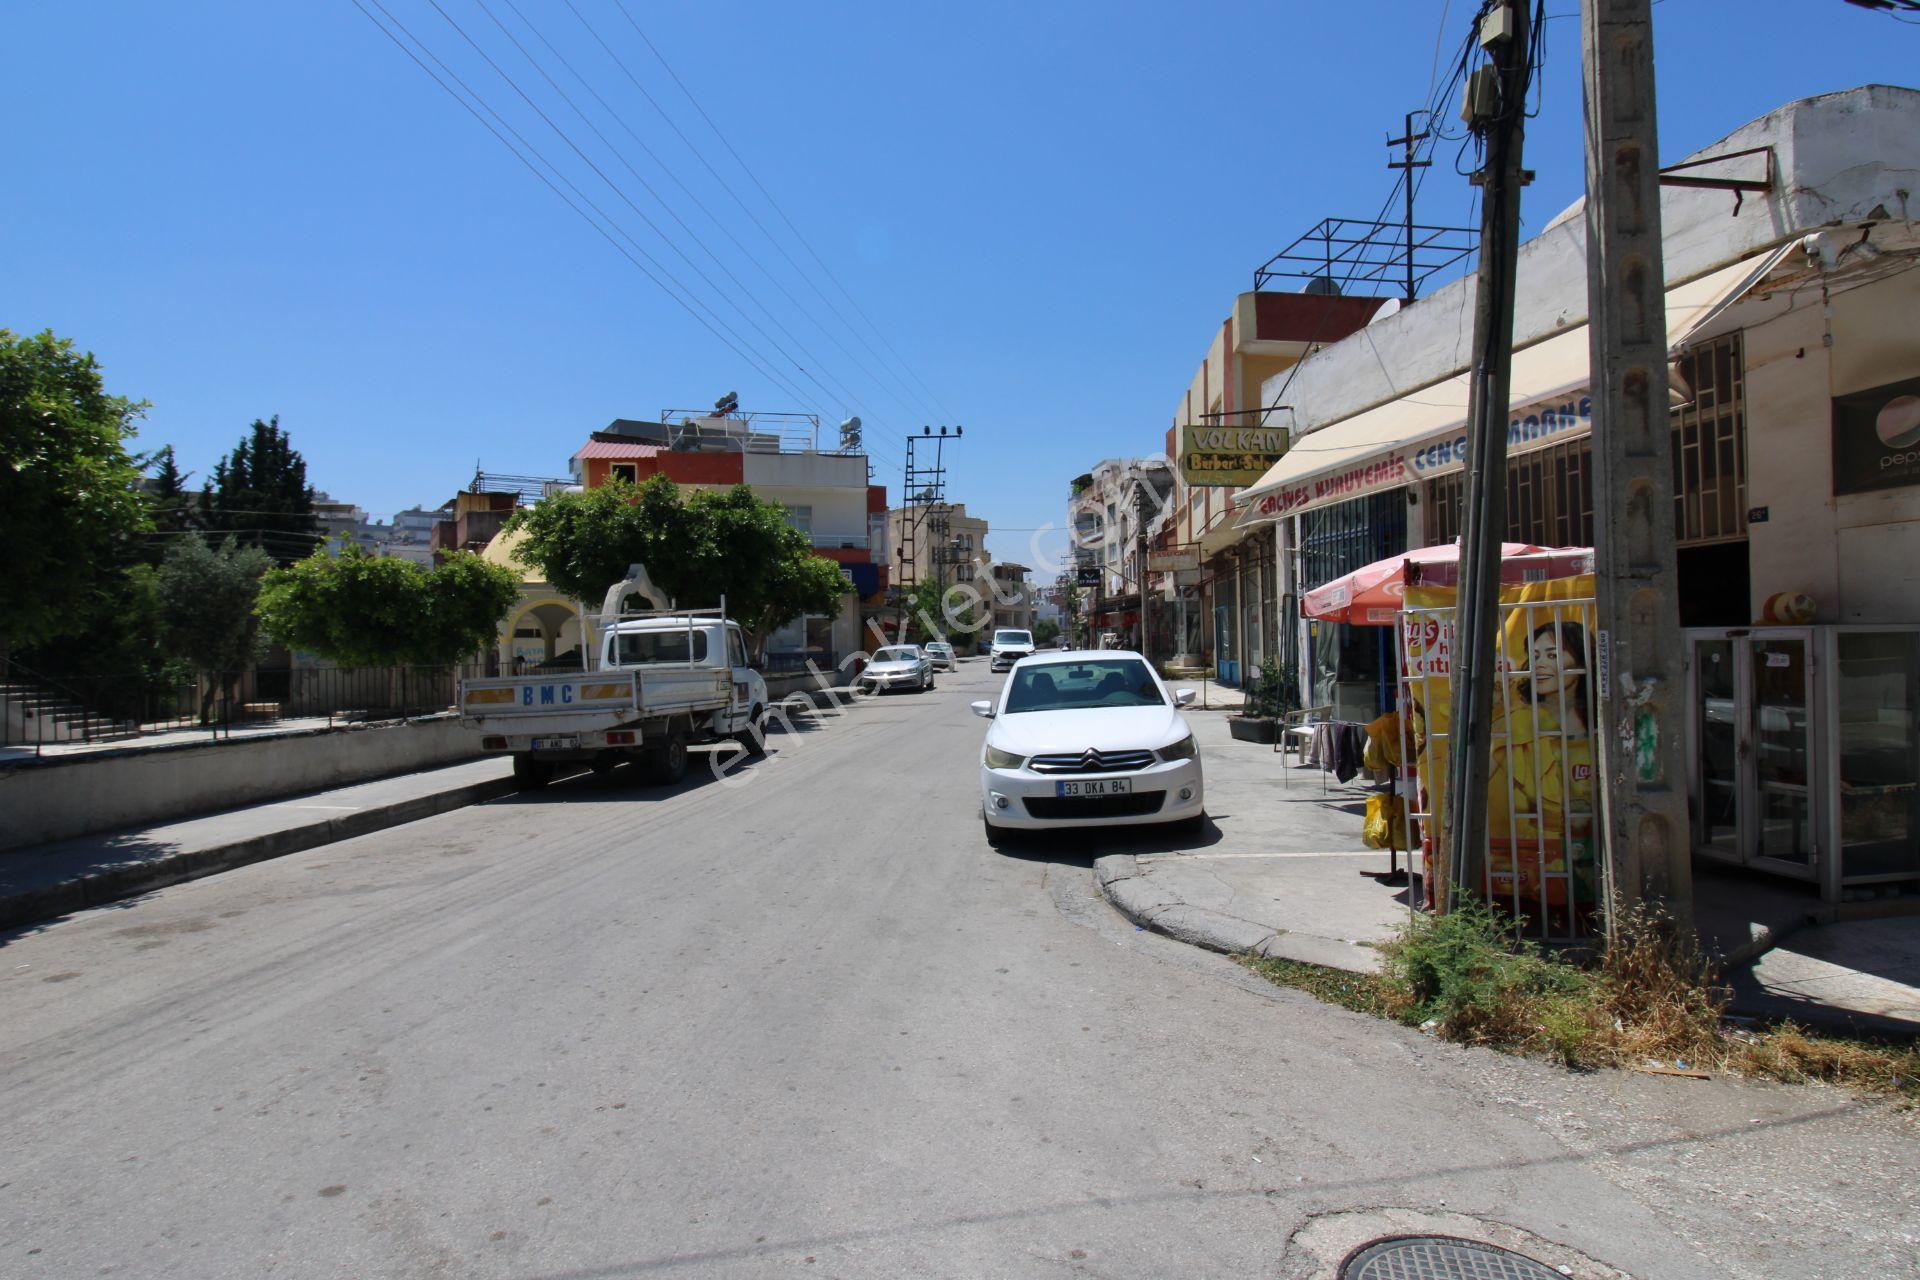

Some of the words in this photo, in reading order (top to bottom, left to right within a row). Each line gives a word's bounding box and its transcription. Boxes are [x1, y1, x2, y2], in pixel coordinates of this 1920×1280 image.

[1508, 396, 1592, 446] MARKE
[1193, 431, 1282, 451] VOLKAN
[523, 684, 572, 706] BMC
[1065, 783, 1079, 795] 33
[1085, 782, 1105, 794] DKA
[1112, 781, 1125, 792] 84
